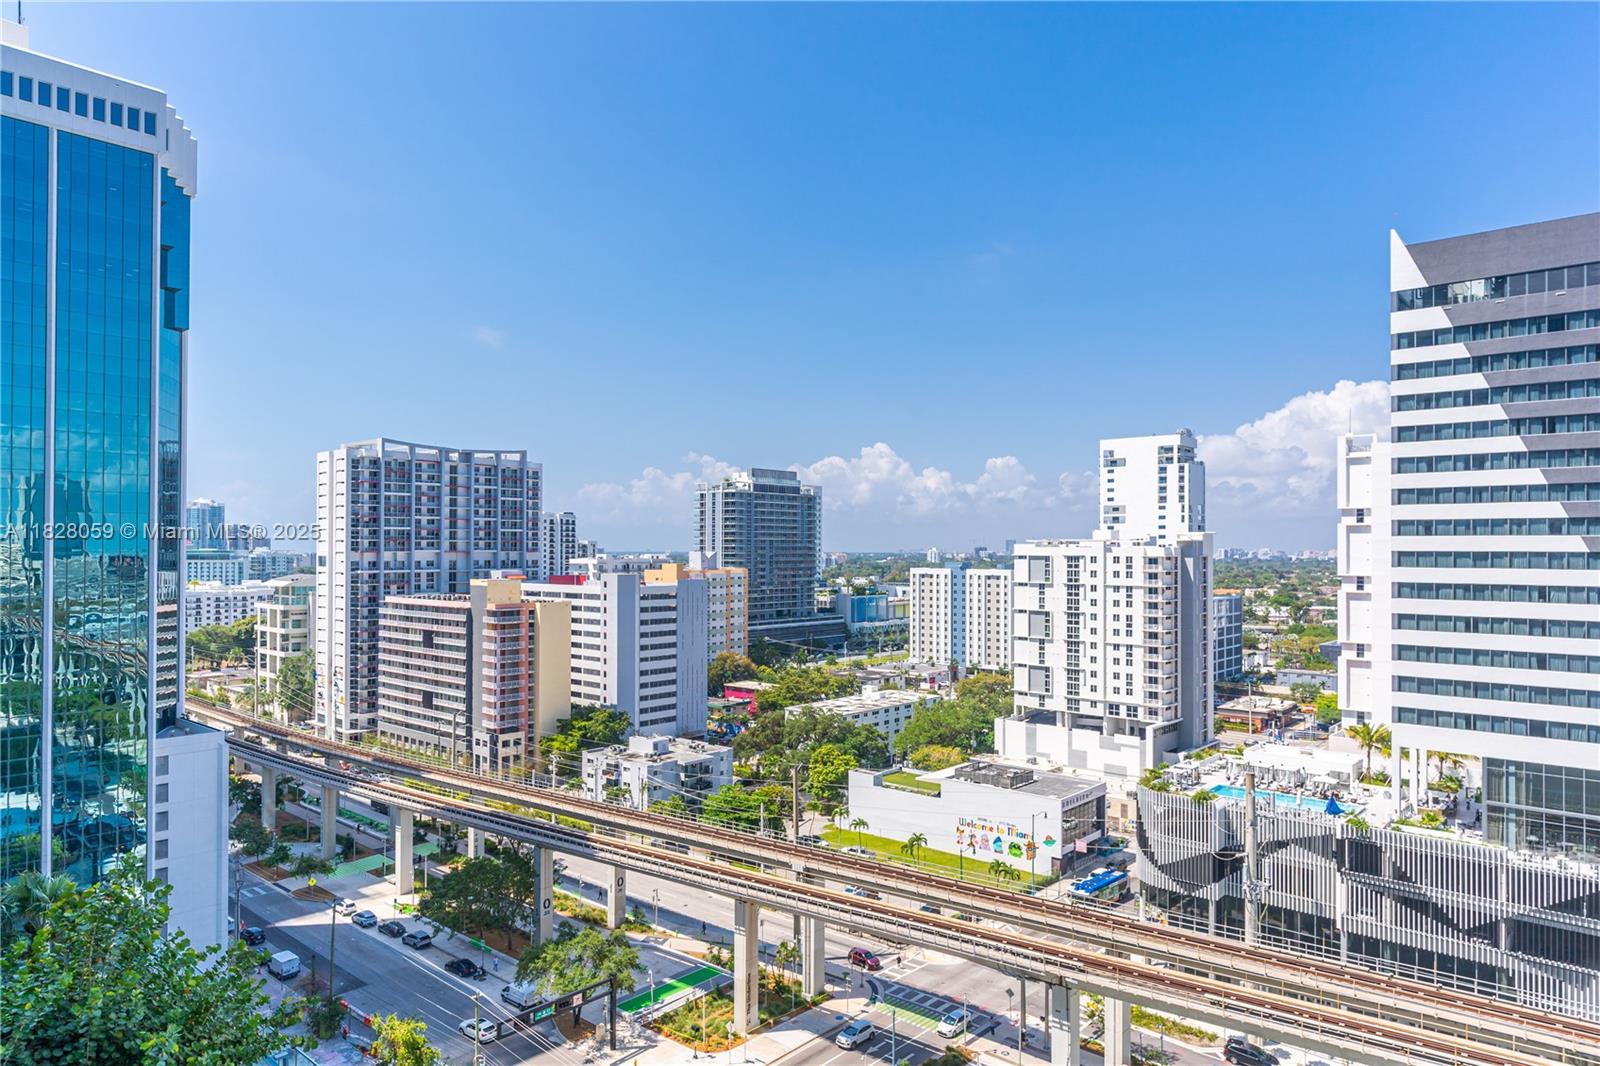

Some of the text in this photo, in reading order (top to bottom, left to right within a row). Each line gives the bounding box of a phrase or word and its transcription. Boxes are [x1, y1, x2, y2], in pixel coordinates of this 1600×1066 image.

[958, 817, 994, 832] Welcome
[997, 825, 1005, 834] to
[1007, 826, 1032, 840] Miam
